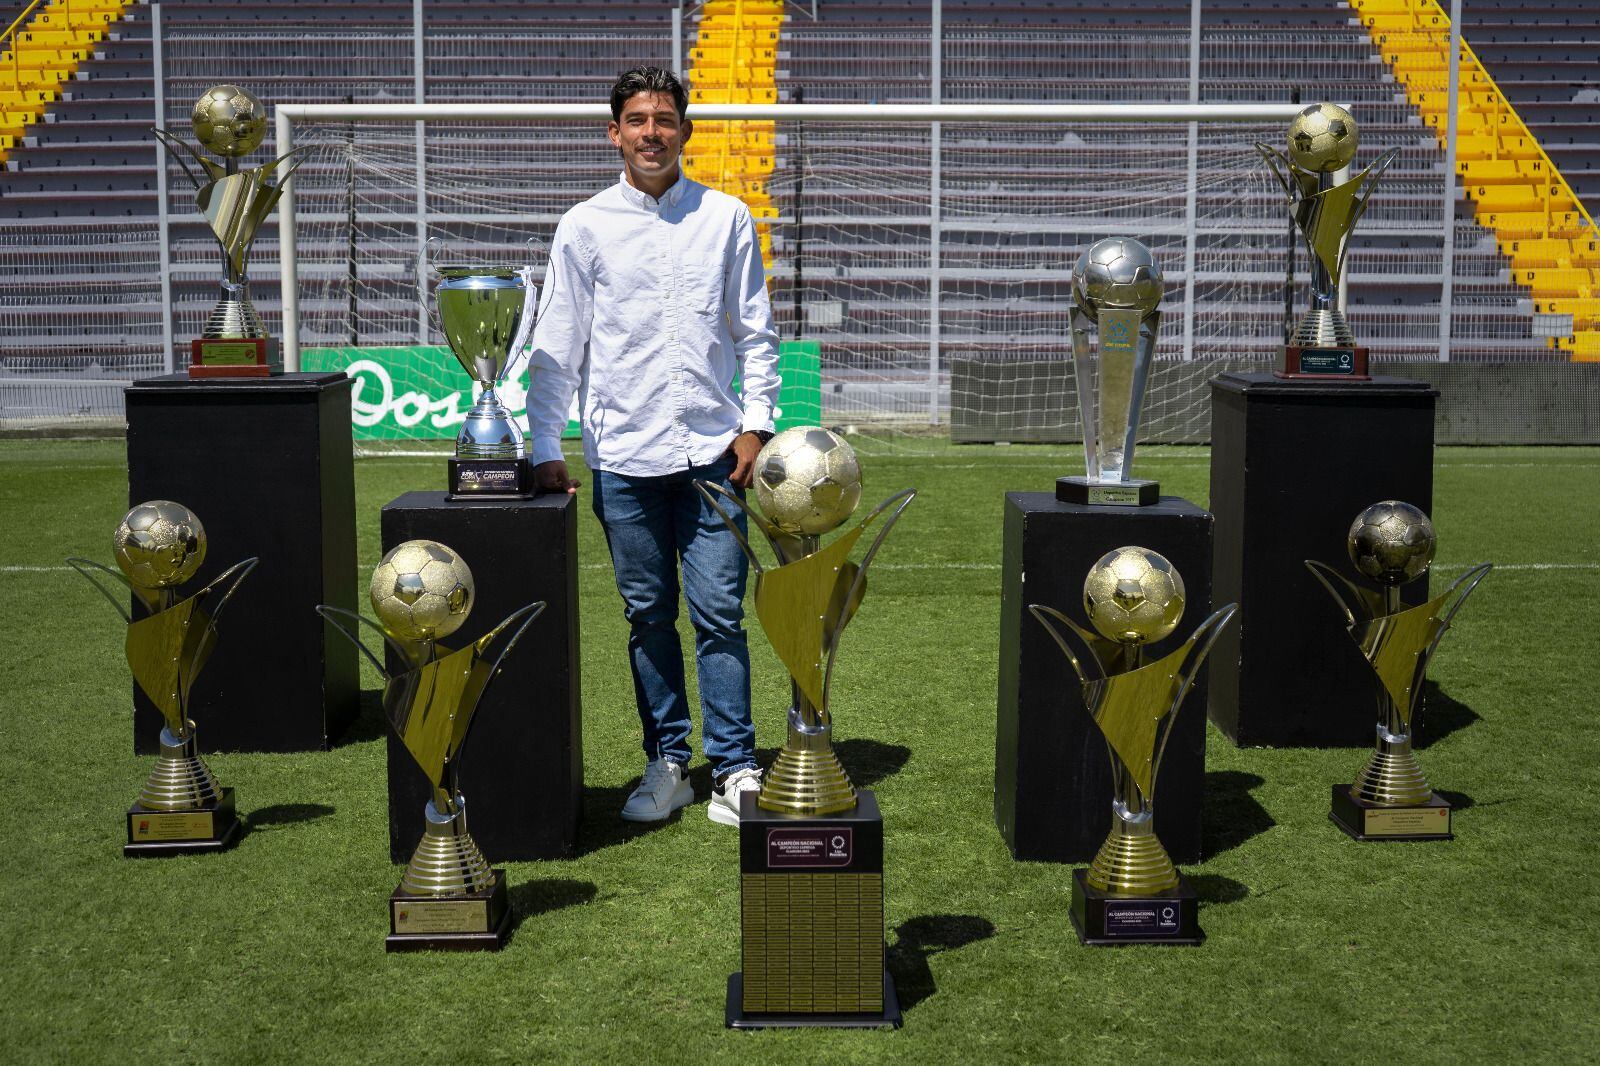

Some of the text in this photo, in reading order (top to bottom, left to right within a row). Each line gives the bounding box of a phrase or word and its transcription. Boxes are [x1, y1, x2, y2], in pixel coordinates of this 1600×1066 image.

[1461, 162, 1468, 171] H
[1534, 162, 1540, 171] H
[1478, 187, 1486, 196] G
[1550, 186, 1558, 196] G
[1528, 272, 1535, 280] D
[1549, 302, 1556, 312] C
[344, 360, 469, 428] Dos
